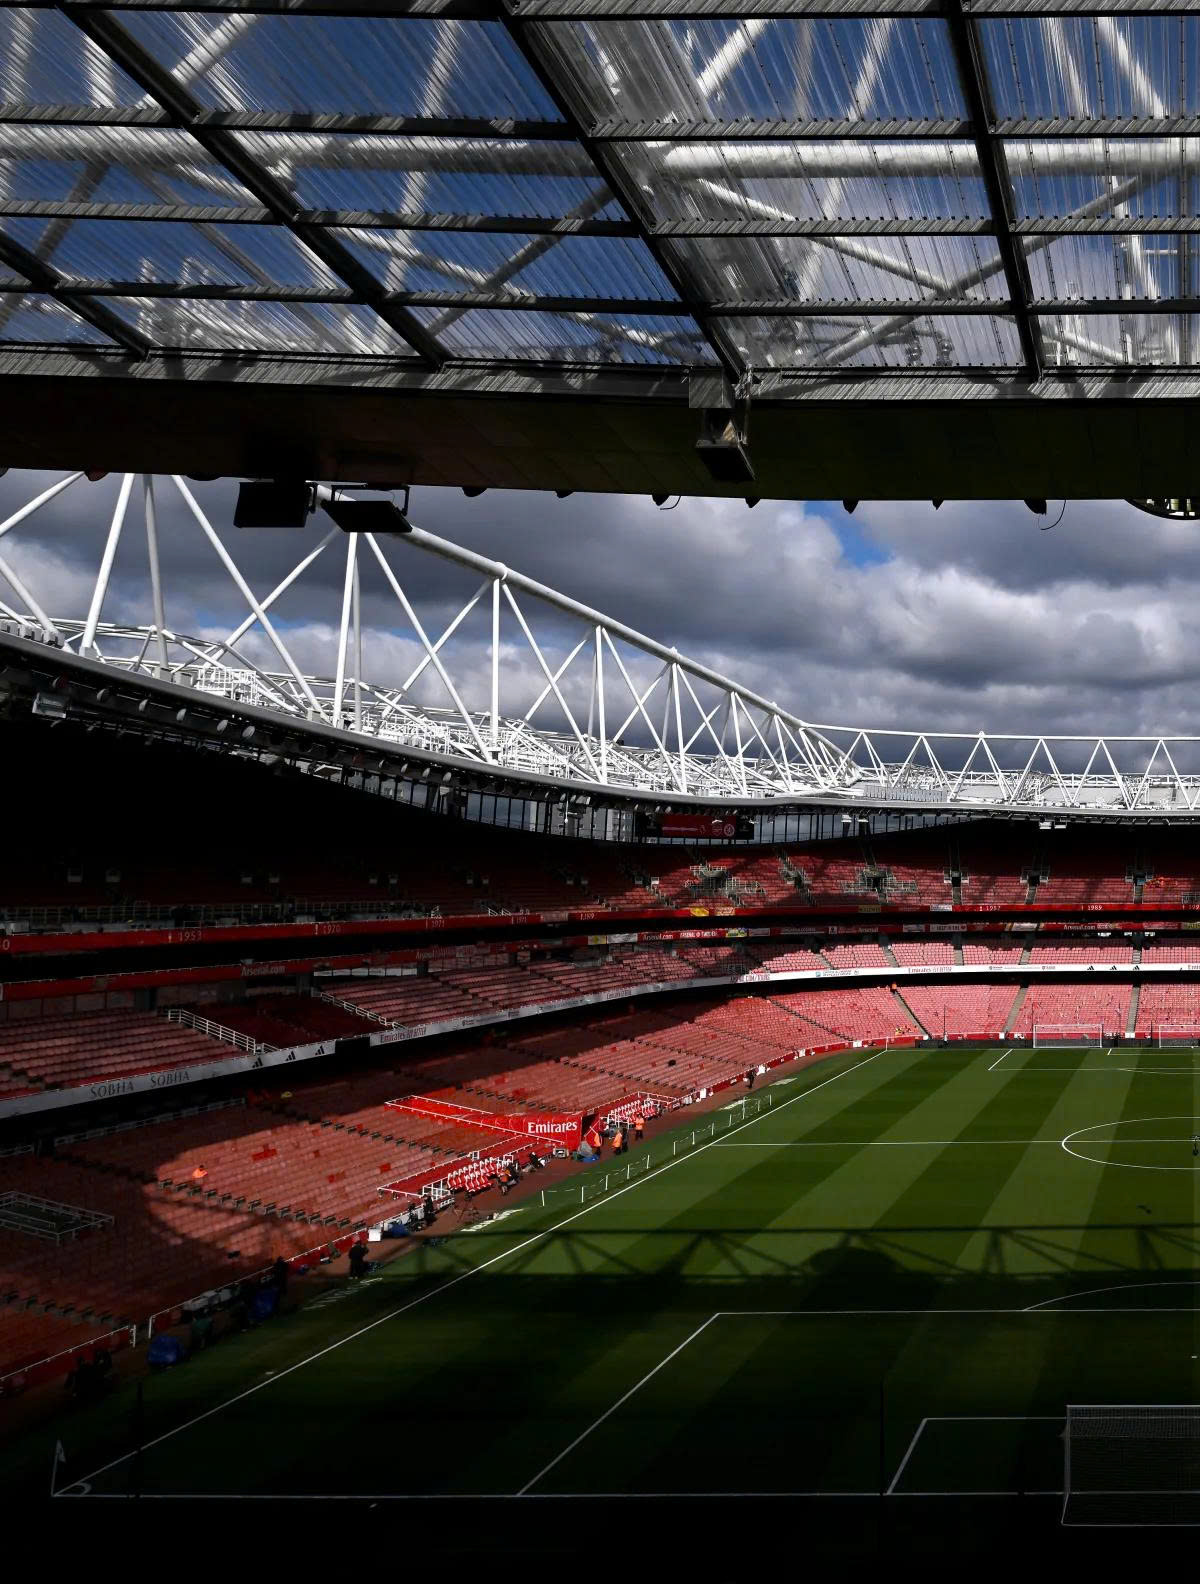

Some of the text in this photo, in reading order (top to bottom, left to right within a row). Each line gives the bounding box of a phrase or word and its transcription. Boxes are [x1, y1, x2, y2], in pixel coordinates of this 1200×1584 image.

[179, 931, 203, 943] 1953
[241, 965, 287, 977] Arsenal.com
[380, 1032, 406, 1044] Emirates
[90, 1071, 191, 1099] SOBHA SOBHA
[527, 1120, 578, 1134] Emirates
